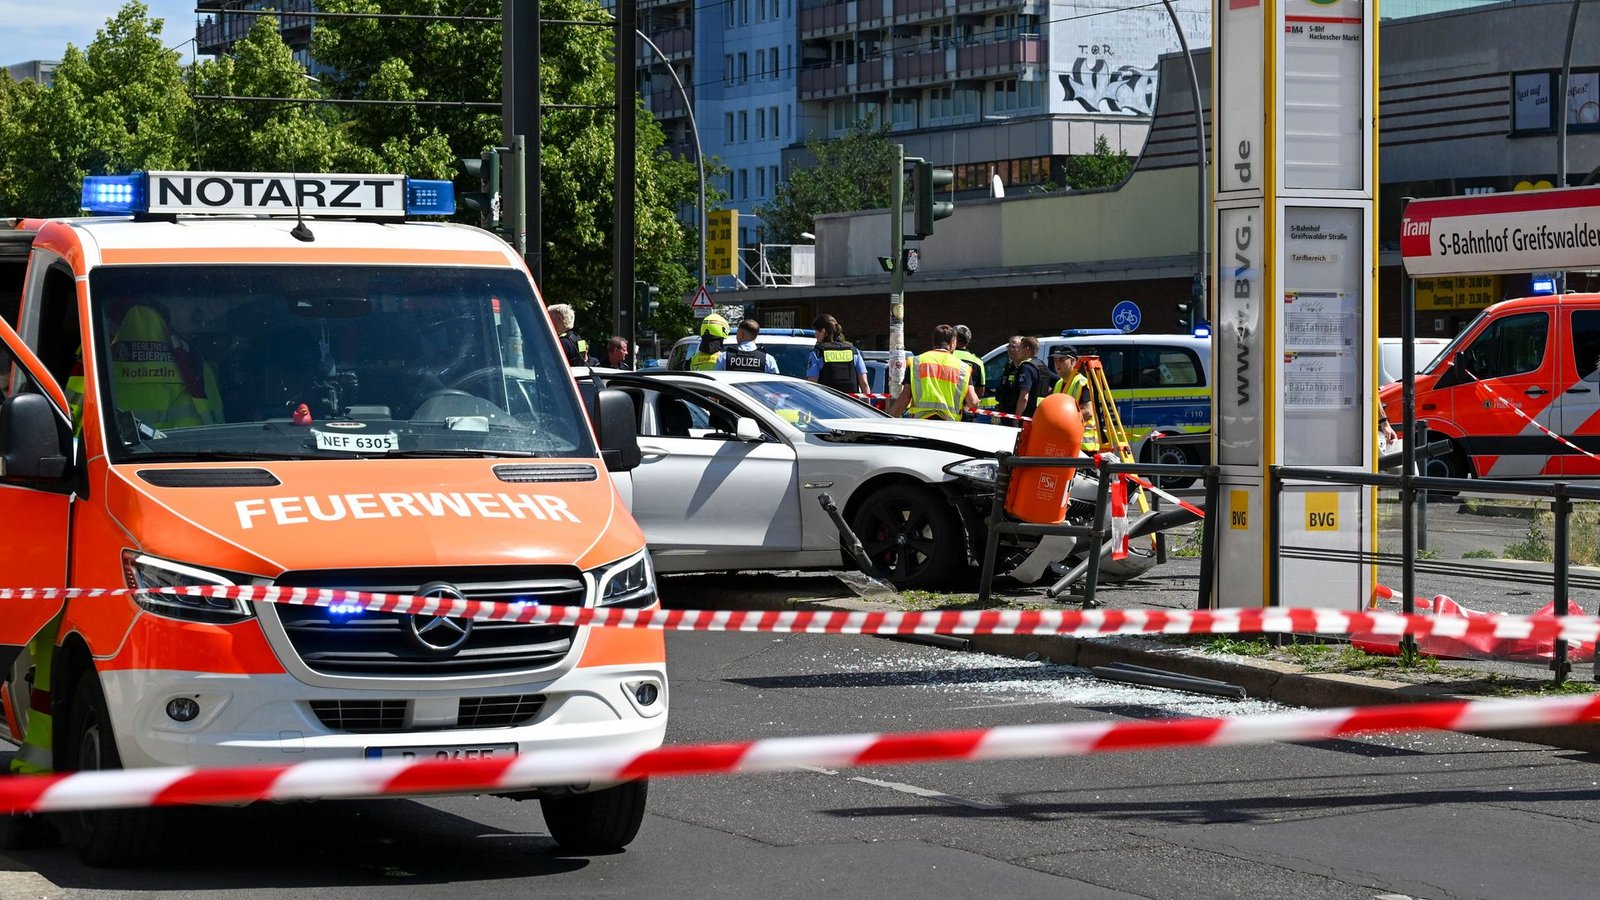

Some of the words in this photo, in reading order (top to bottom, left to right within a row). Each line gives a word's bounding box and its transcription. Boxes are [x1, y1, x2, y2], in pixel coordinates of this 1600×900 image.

[1292, 26, 1303, 34] M4
[159, 177, 394, 208] NOTARZT
[1291, 224, 1321, 232] S-Bahnhof
[1402, 218, 1430, 237] Tram
[1439, 228, 1509, 256] S-Bahnhof
[132, 351, 173, 362] FEUERWE
[825, 350, 852, 361] POLIZEI
[730, 357, 761, 367] POLIZEI
[122, 367, 175, 377] Notärztin
[1190, 410, 1204, 418] 110
[323, 436, 350, 447] NEF
[356, 437, 392, 449] 6305
[1040, 476, 1055, 488] BSR
[234, 492, 582, 529] FEUERWEHR
[1232, 511, 1246, 526] BVG
[1309, 512, 1335, 527] BVG
